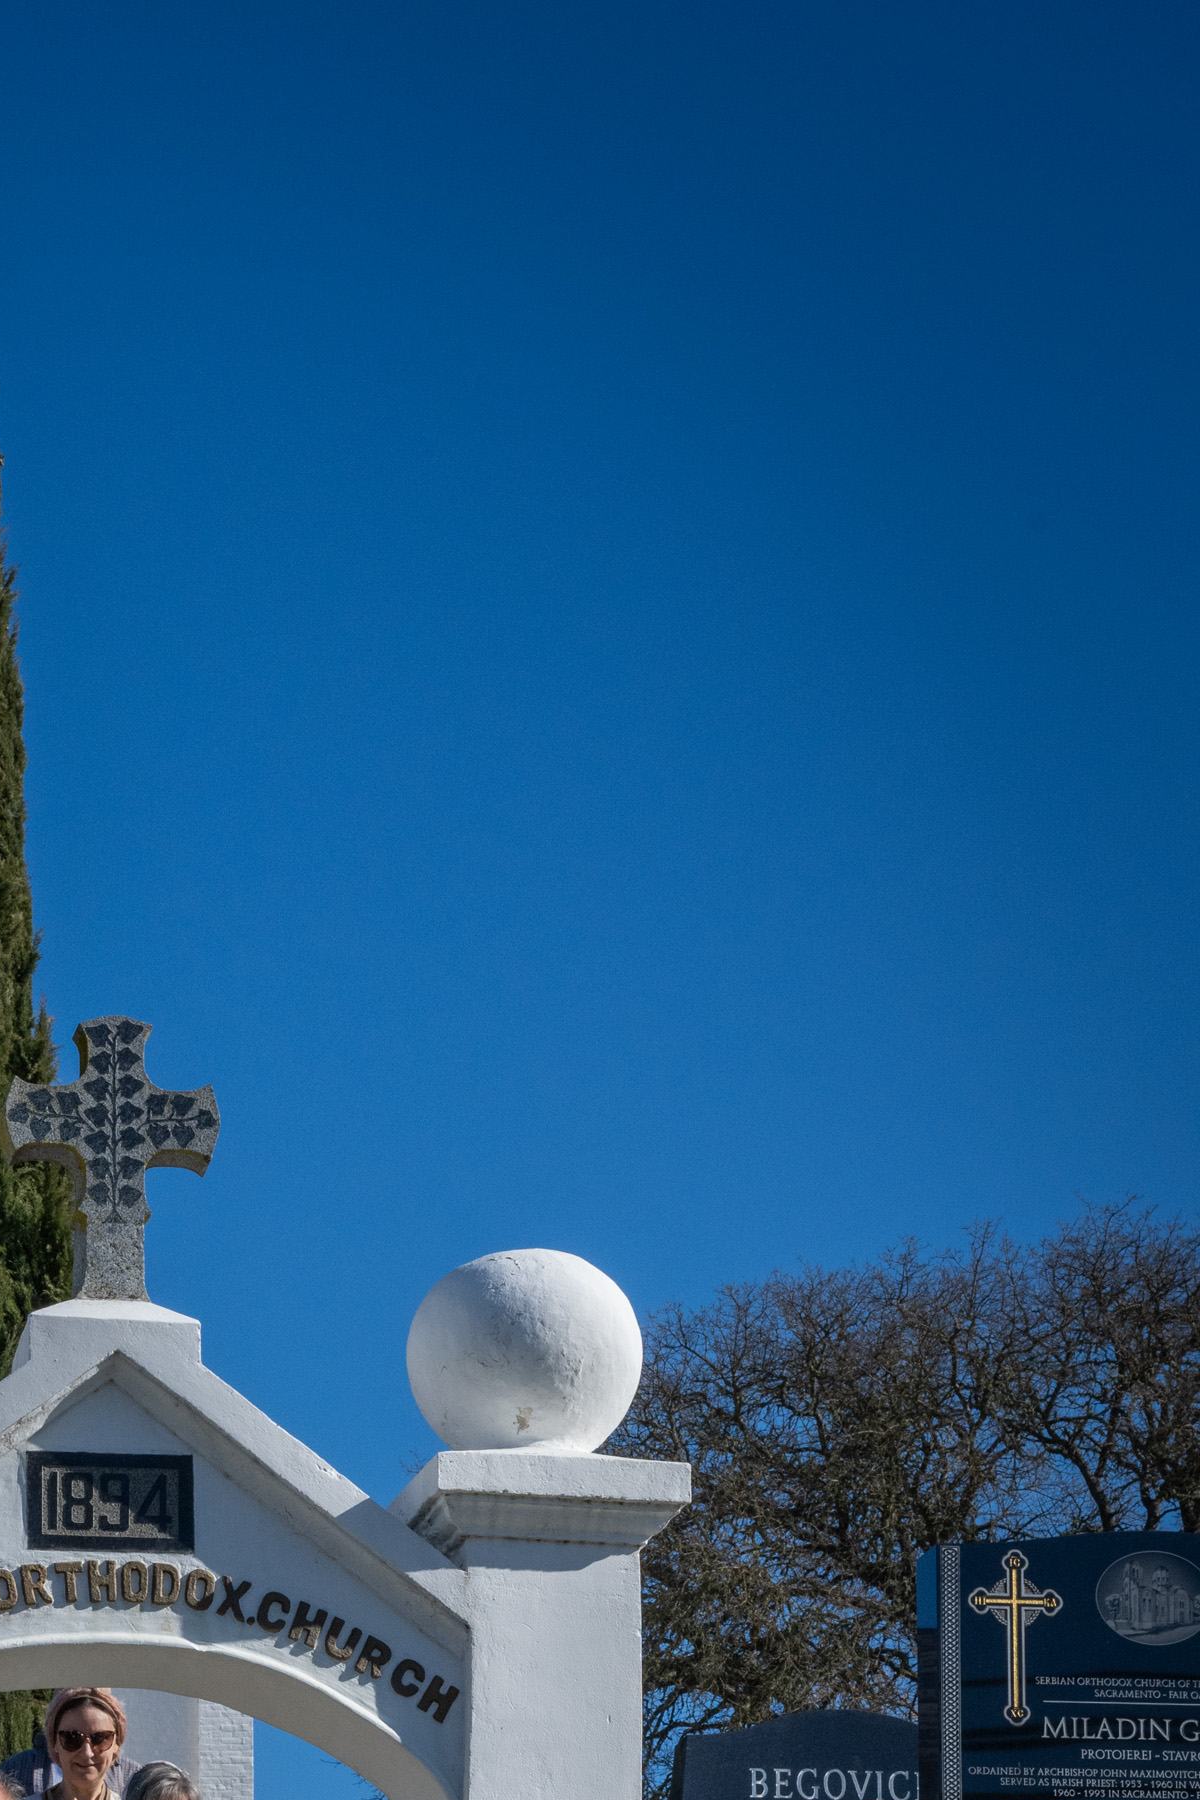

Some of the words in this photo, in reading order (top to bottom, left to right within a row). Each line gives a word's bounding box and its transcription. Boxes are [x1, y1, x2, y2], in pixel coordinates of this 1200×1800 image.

[47, 1471, 173, 1533] 1894
[256, 1591, 460, 1724] CHURCH
[1035, 1676, 1075, 1686] SERBIAN
[1077, 1677, 1133, 1687] ORTHODOX
[1134, 1678, 1176, 1688] CHURCH
[1178, 1679, 1191, 1688] OF
[1094, 1689, 1161, 1699] SACRAMENTO
[1169, 1690, 1189, 1699] FAIR
[1190, 1691, 1200, 1700] O
[1041, 1716, 1172, 1742] MILADIN
[1080, 1749, 1152, 1761] PROTOJEREJ
[968, 1766, 1022, 1776] ORDAINED
[1023, 1767, 1036, 1776] BY
[1037, 1767, 1099, 1777] ARCHBISHOP
[1100, 1768, 1128, 1778] JOHN
[1129, 1769, 1200, 1779] MAXIMOVITCH
[1000, 1777, 1036, 1786] SERVED
[1038, 1778, 1050, 1787] AS
[1051, 1778, 1084, 1787] PARISH
[1086, 1779, 1118, 1788] PRIEST:
[1120, 1779, 1142, 1788] 1953
[1151, 1780, 1173, 1789] 1960
[1175, 1781, 1187, 1789] IN
[1053, 1788, 1076, 1797] 1960
[1084, 1789, 1106, 1798] 1993
[1108, 1790, 1120, 1798] IN
[1121, 1790, 1189, 1800] SACRAMENTO
